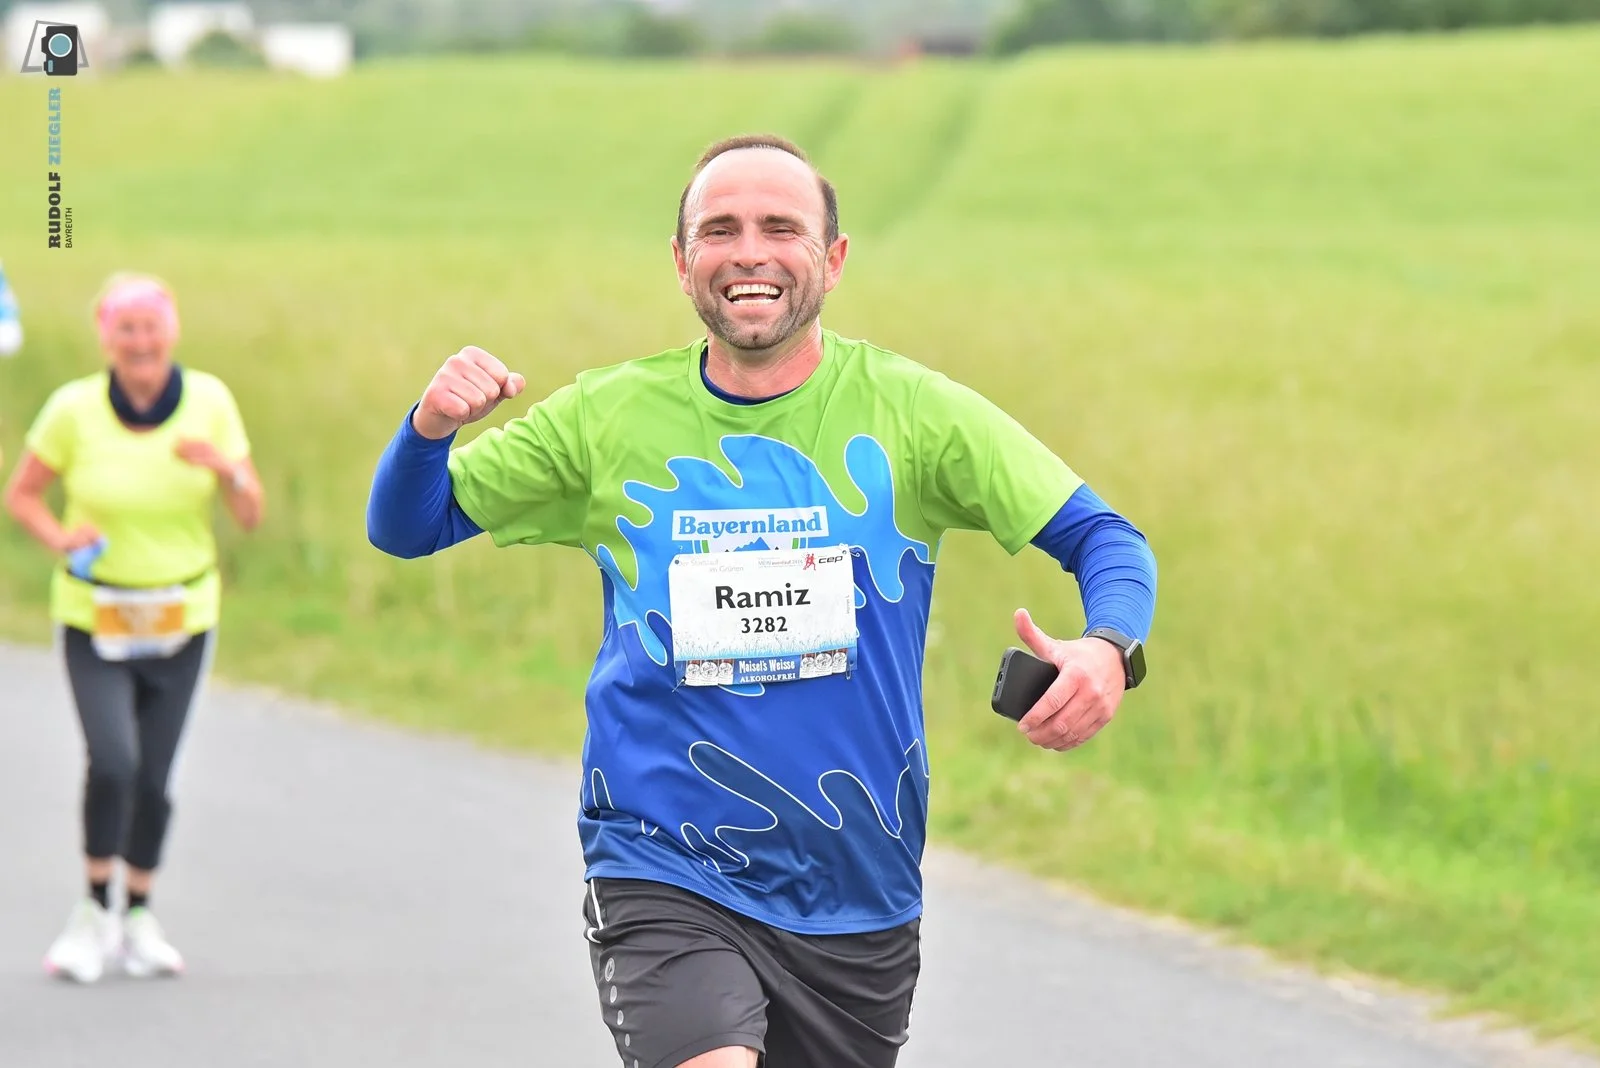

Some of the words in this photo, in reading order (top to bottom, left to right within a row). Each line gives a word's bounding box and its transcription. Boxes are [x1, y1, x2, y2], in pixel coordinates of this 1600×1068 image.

[678, 512, 822, 538] Bayernland
[818, 555, 844, 564] cep
[715, 582, 811, 609] Ramiz
[740, 616, 788, 634] 3282
[739, 660, 768, 674] Maisel's
[769, 659, 796, 672] Weisse
[740, 672, 797, 683] ALKOHOLFREI
